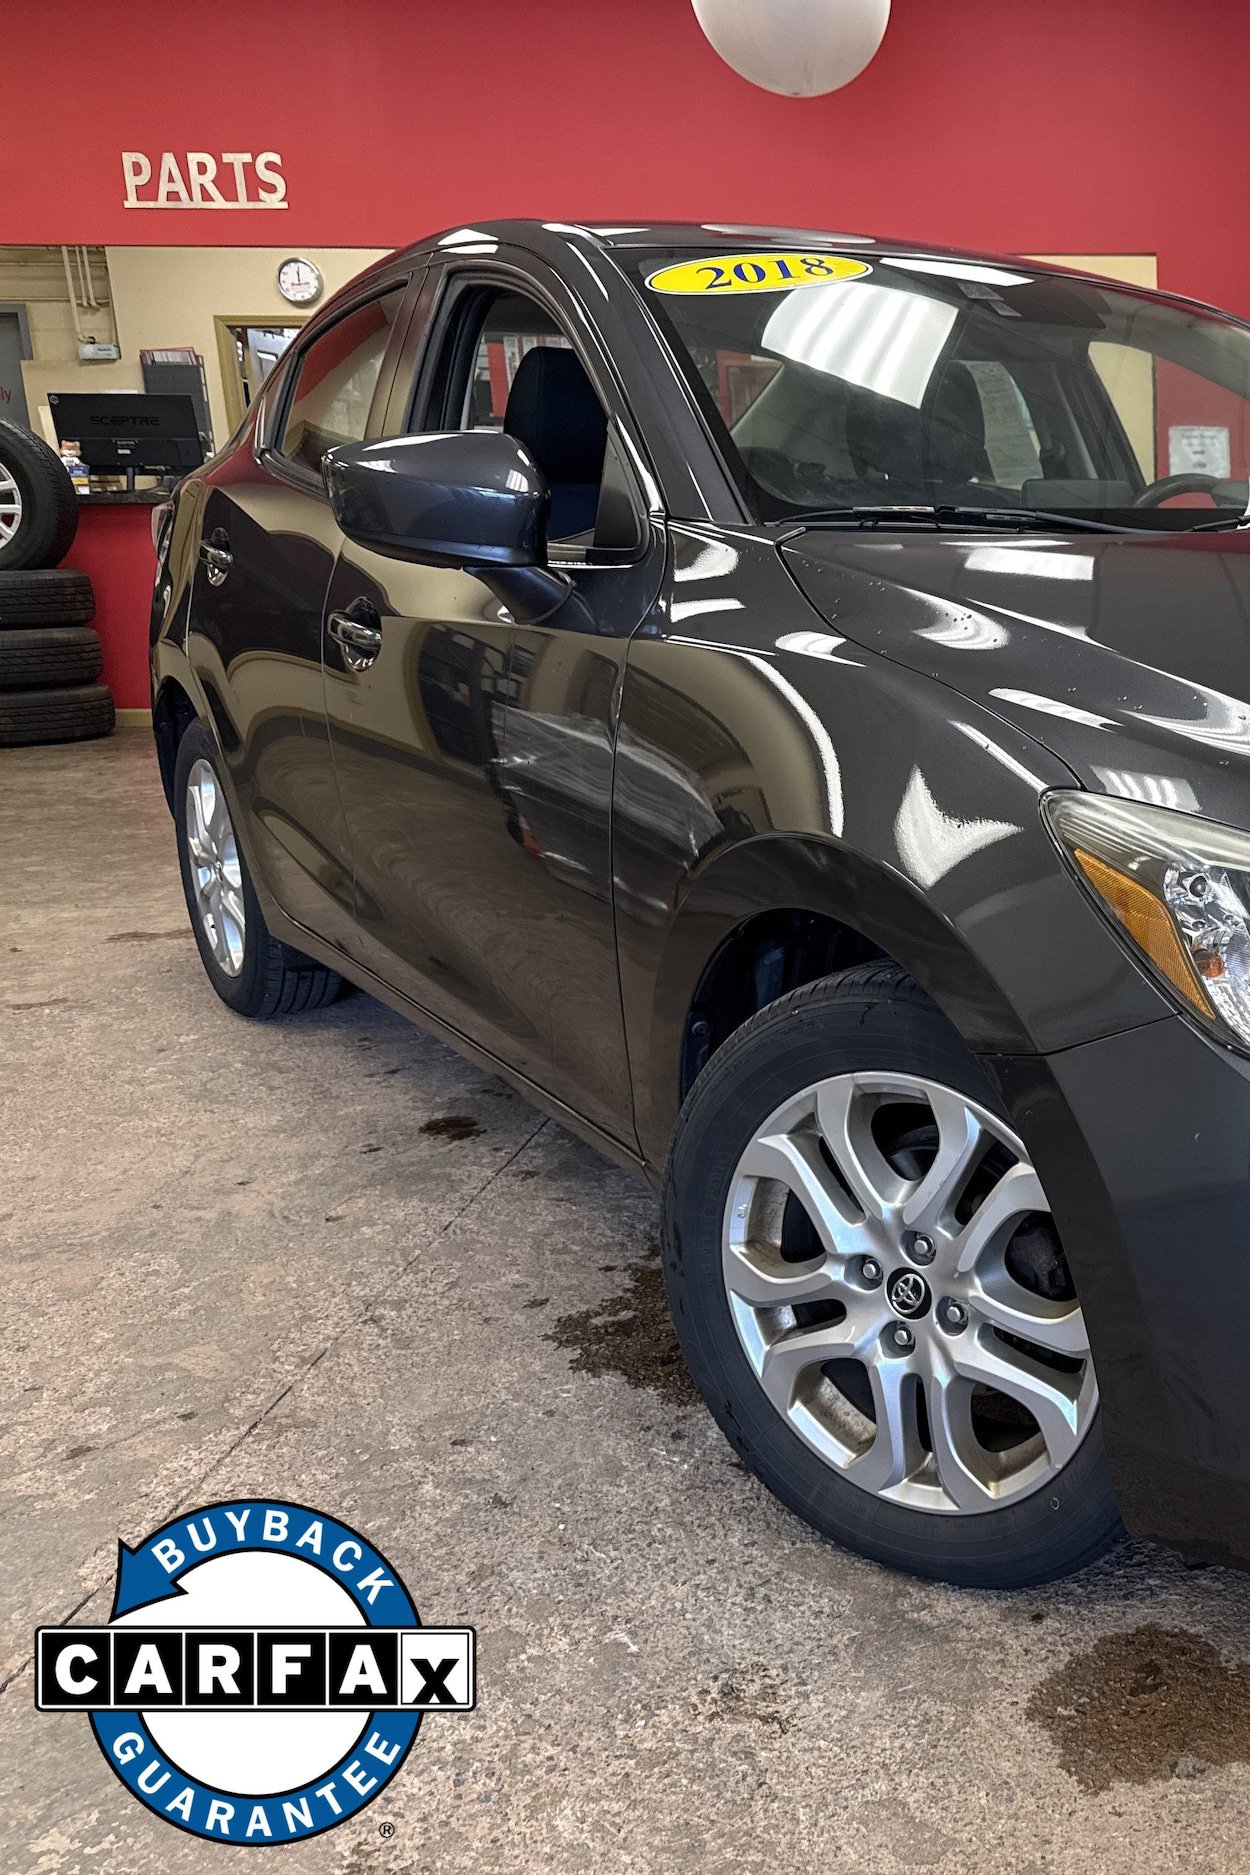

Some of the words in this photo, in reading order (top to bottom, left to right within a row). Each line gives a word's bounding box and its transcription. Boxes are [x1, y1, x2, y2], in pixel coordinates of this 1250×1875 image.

[121, 151, 288, 205] PARTS
[695, 257, 834, 290] 2018
[89, 415, 161, 426] SCEPTRE
